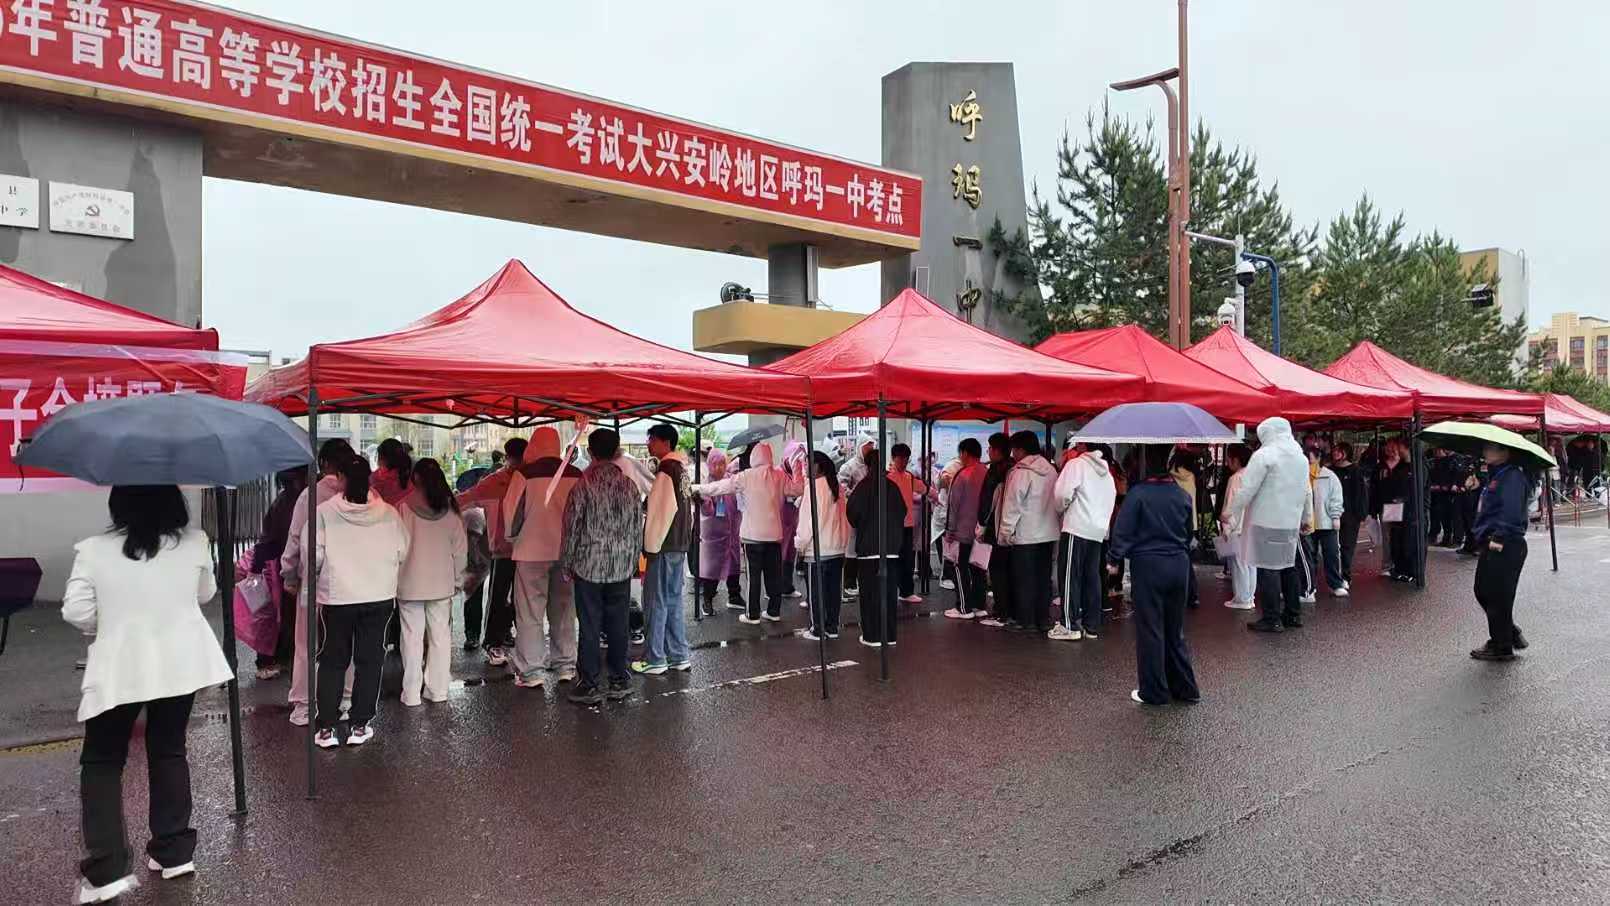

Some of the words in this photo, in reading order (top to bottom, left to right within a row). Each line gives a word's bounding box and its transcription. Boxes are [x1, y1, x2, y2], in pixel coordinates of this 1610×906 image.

[0, 0, 903, 226] 年普通高等学校招生全国统一考试大兴安岭地区呼玛一中考点
[950, 89, 983, 324] 呼玛一中
